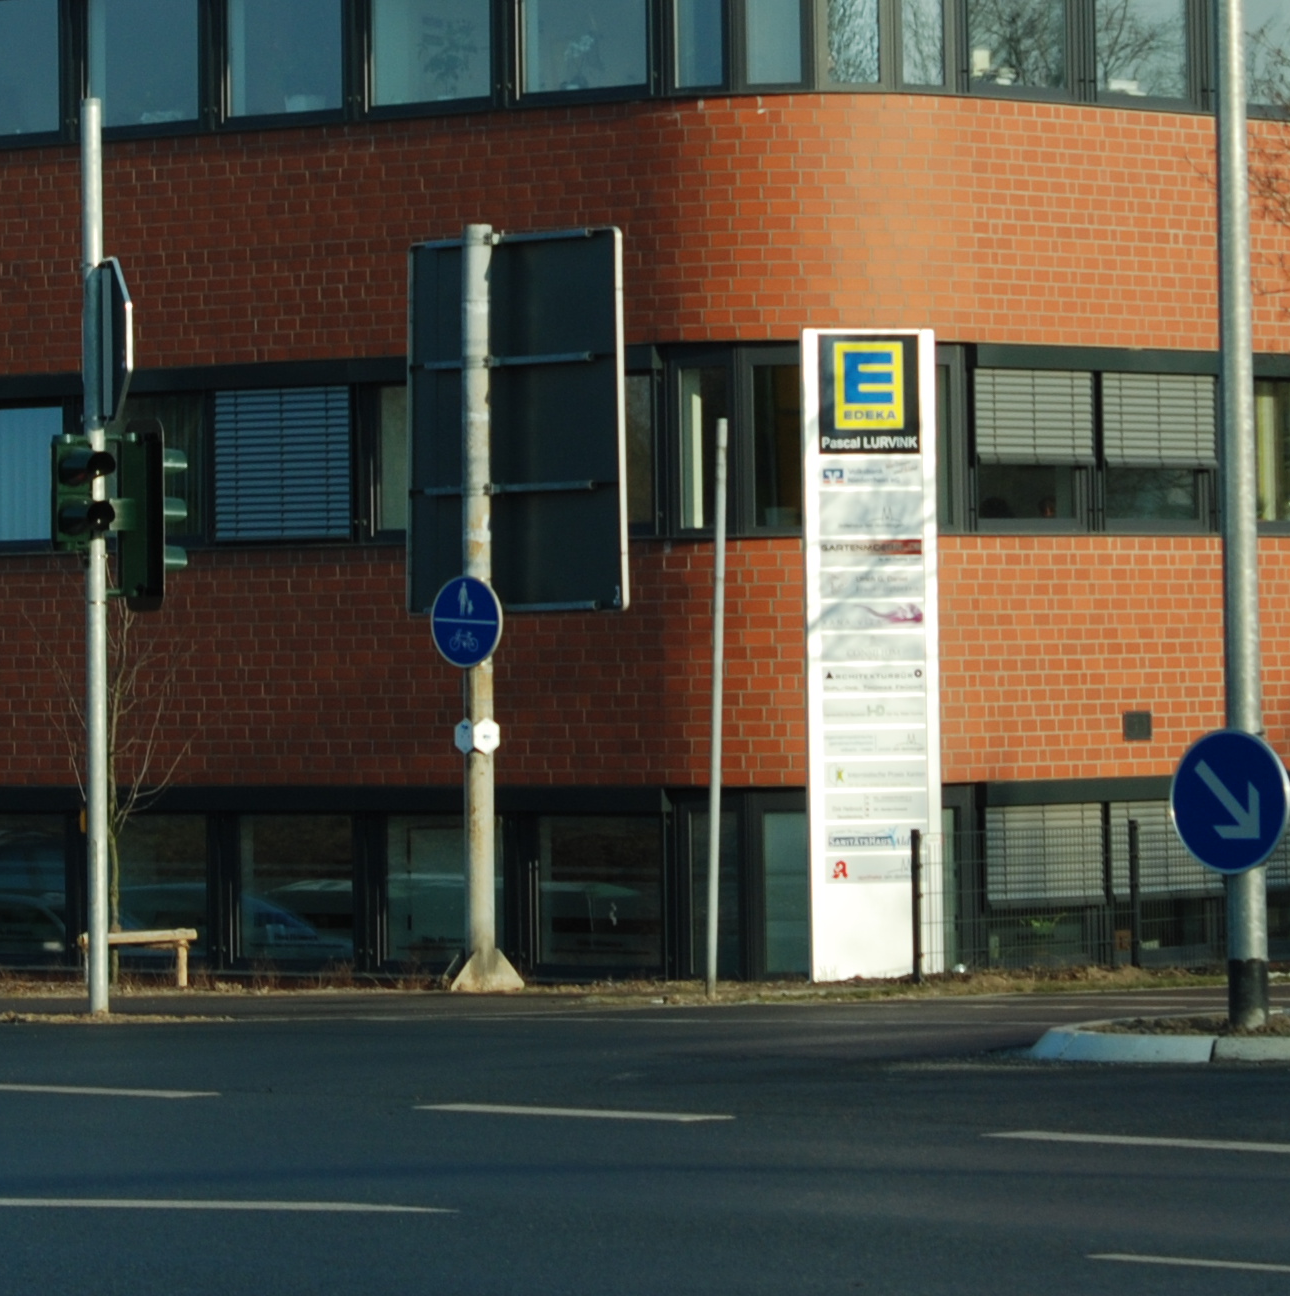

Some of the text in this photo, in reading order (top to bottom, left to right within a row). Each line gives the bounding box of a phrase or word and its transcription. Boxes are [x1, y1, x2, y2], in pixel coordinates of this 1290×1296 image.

[843, 410, 897, 421] EDEKA
[821, 435, 918, 449] Pascal LURVINK
